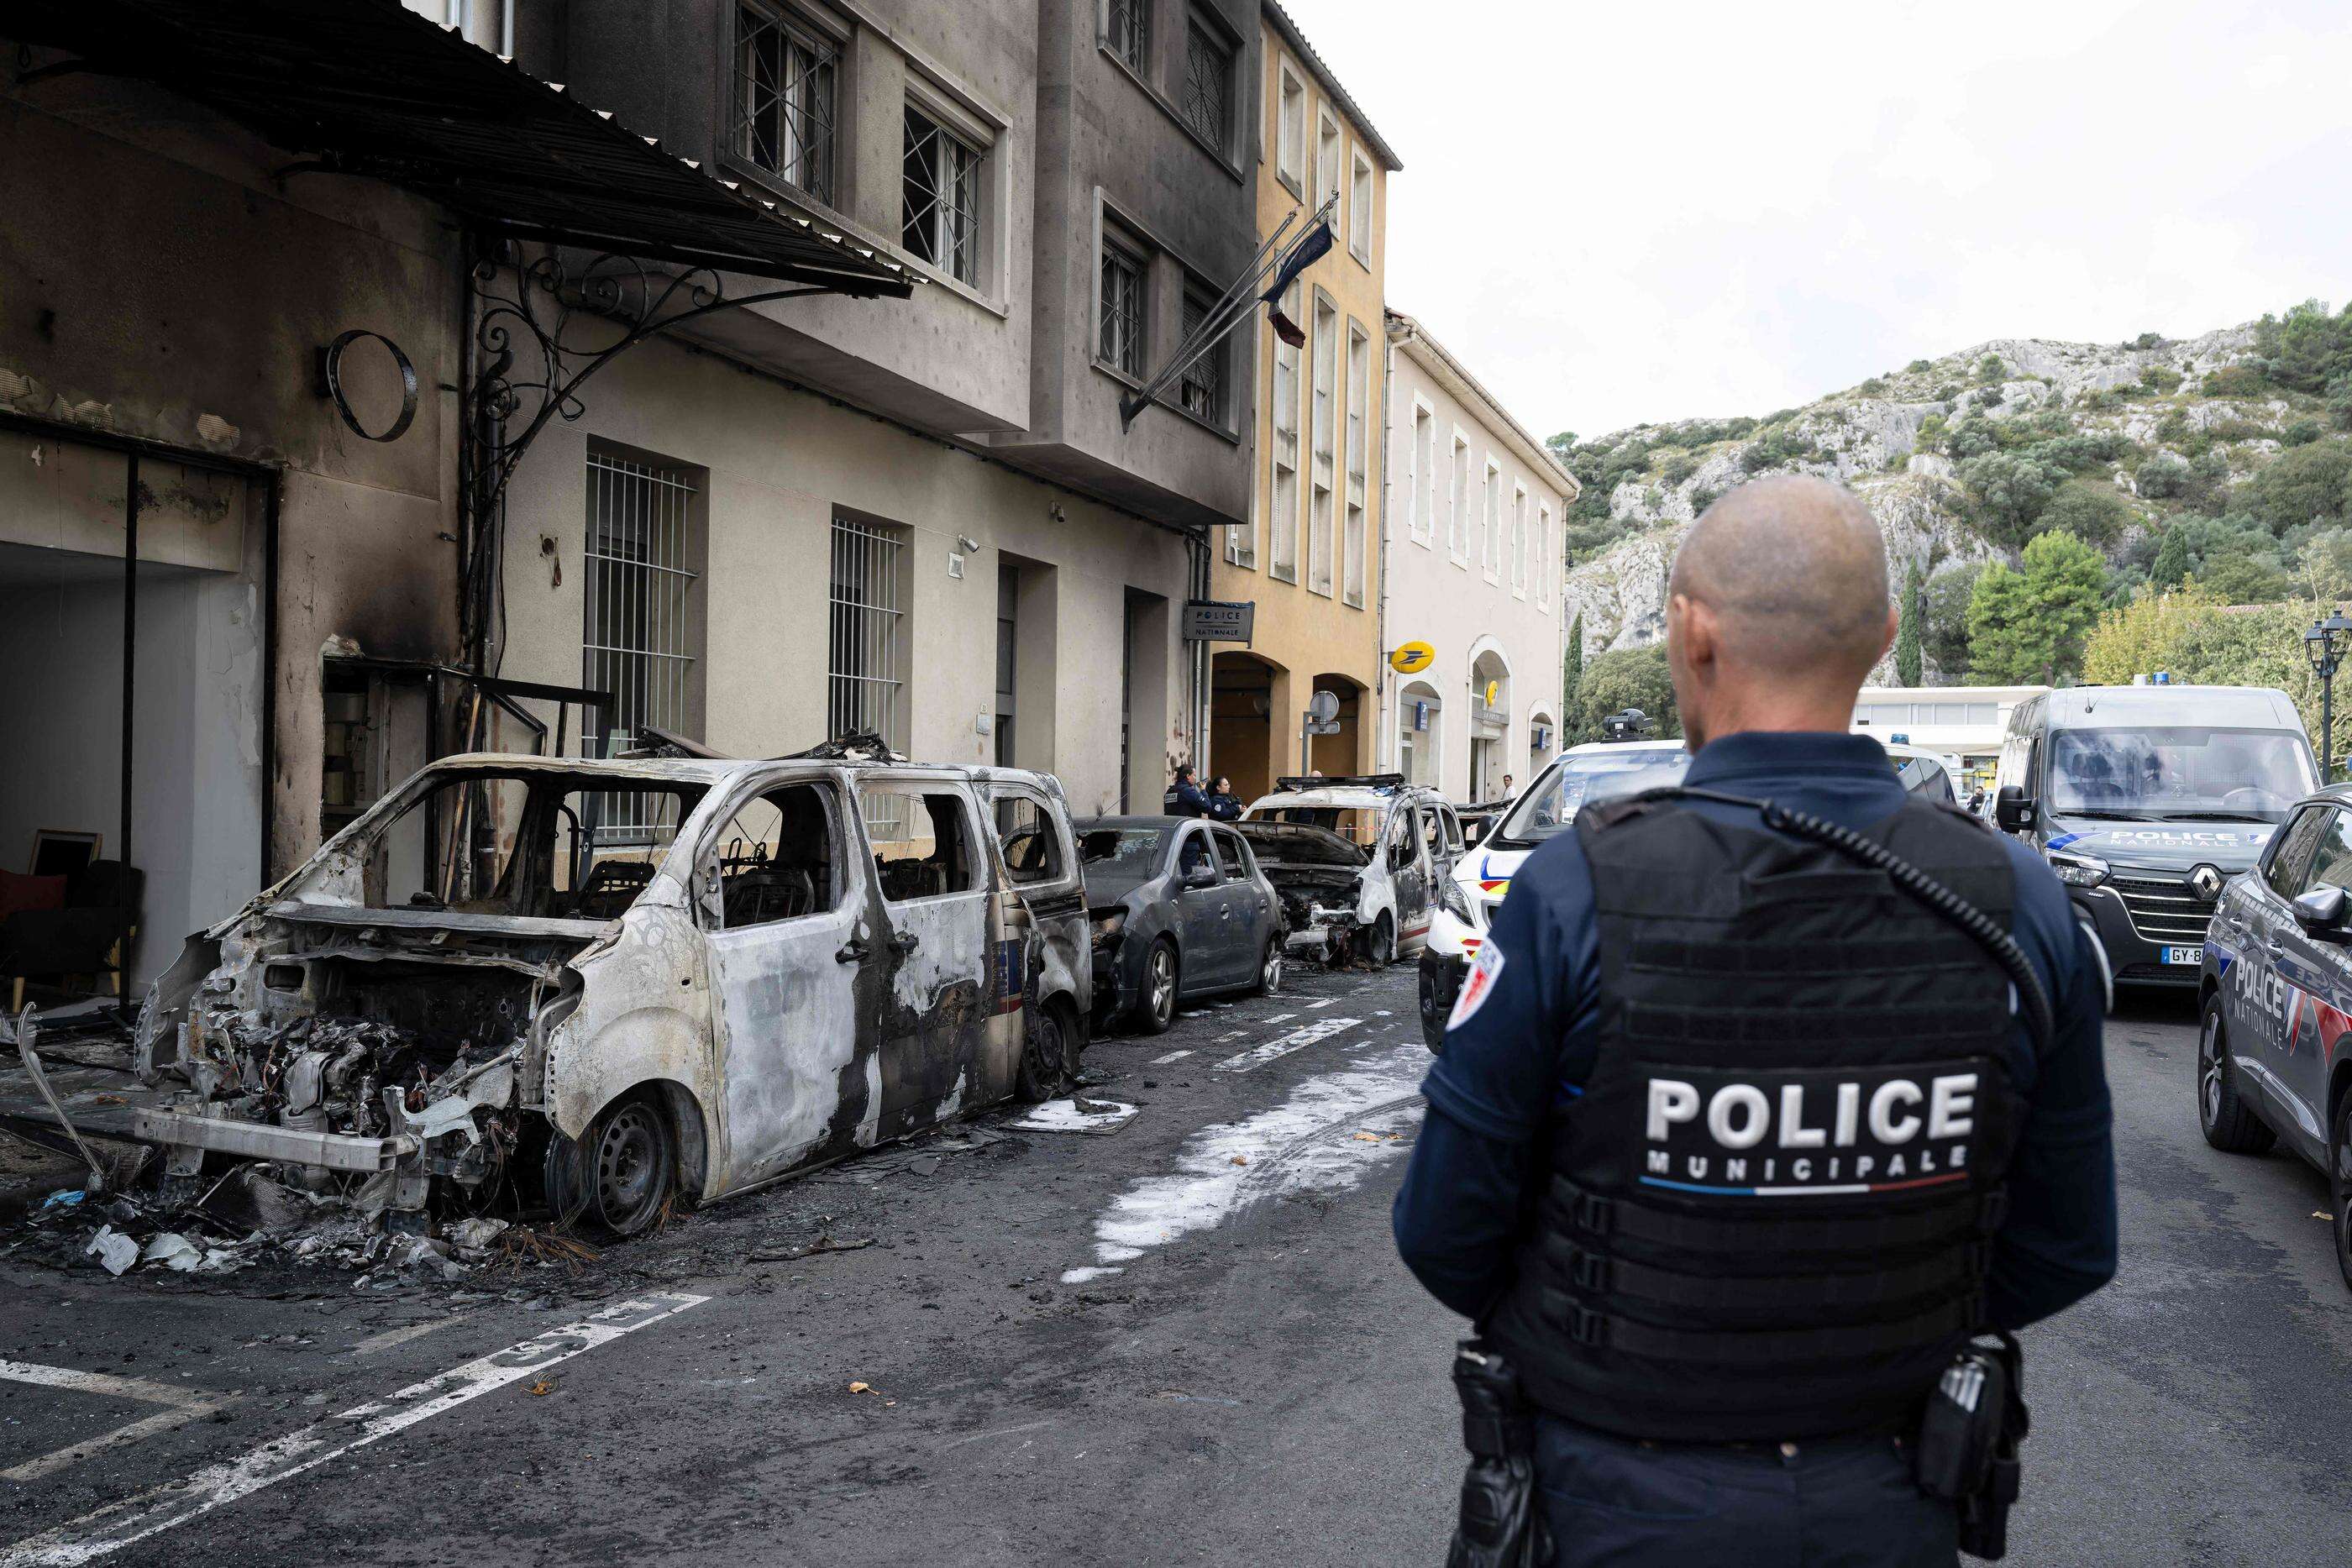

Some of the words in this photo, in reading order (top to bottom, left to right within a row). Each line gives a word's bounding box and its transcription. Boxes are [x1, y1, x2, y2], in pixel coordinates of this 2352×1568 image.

[1196, 611, 1241, 620] POLICE
[2111, 831, 2239, 842] POLICE
[2235, 956, 2284, 1020] POLICE
[2234, 998, 2283, 1050] NATIONALE
[1646, 1073, 1978, 1149] POLICE
[1646, 1145, 1967, 1181] MUNICIPALE
